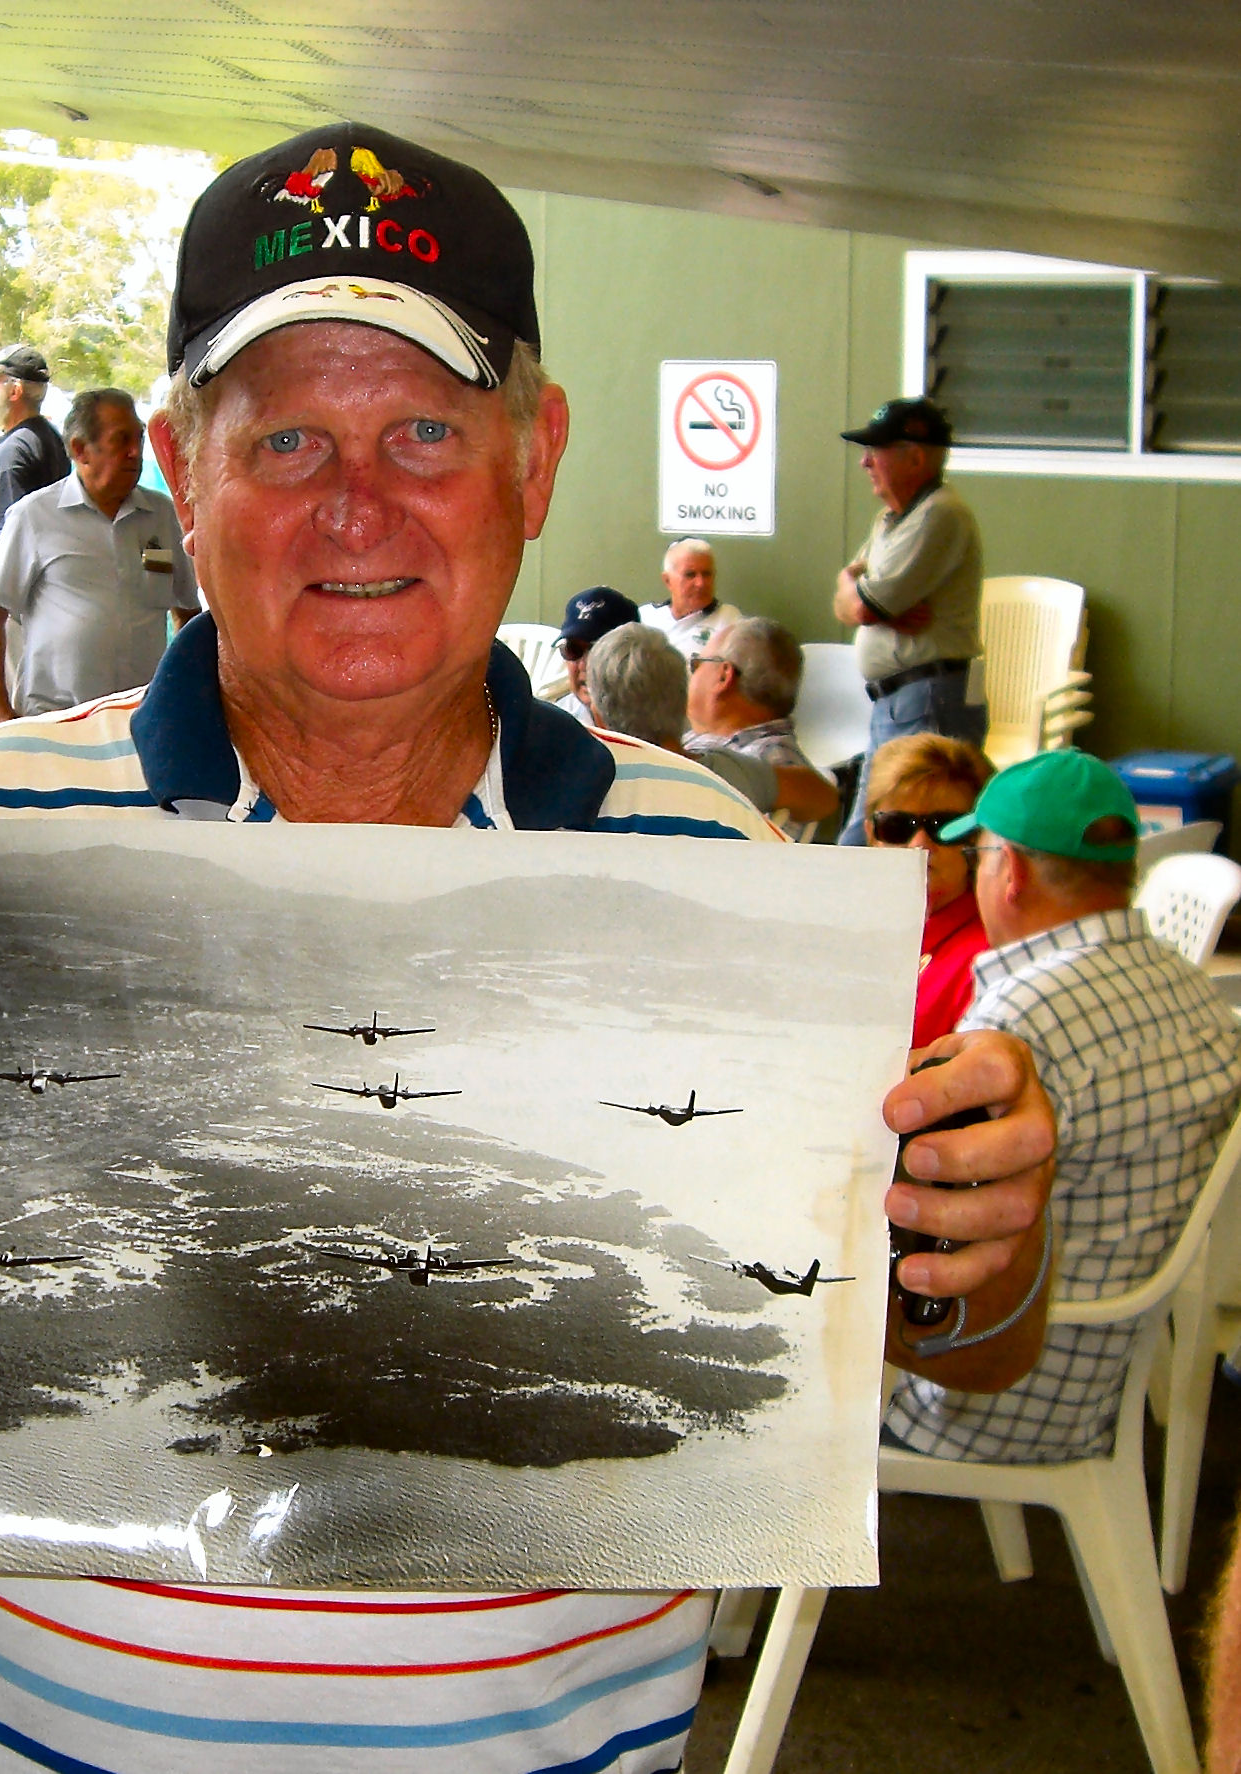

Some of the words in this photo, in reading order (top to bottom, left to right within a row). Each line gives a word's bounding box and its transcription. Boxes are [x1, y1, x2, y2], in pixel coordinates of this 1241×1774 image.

[254, 215, 440, 269] MEXICO
[704, 483, 728, 497] NO
[678, 504, 756, 521] SMOKING
